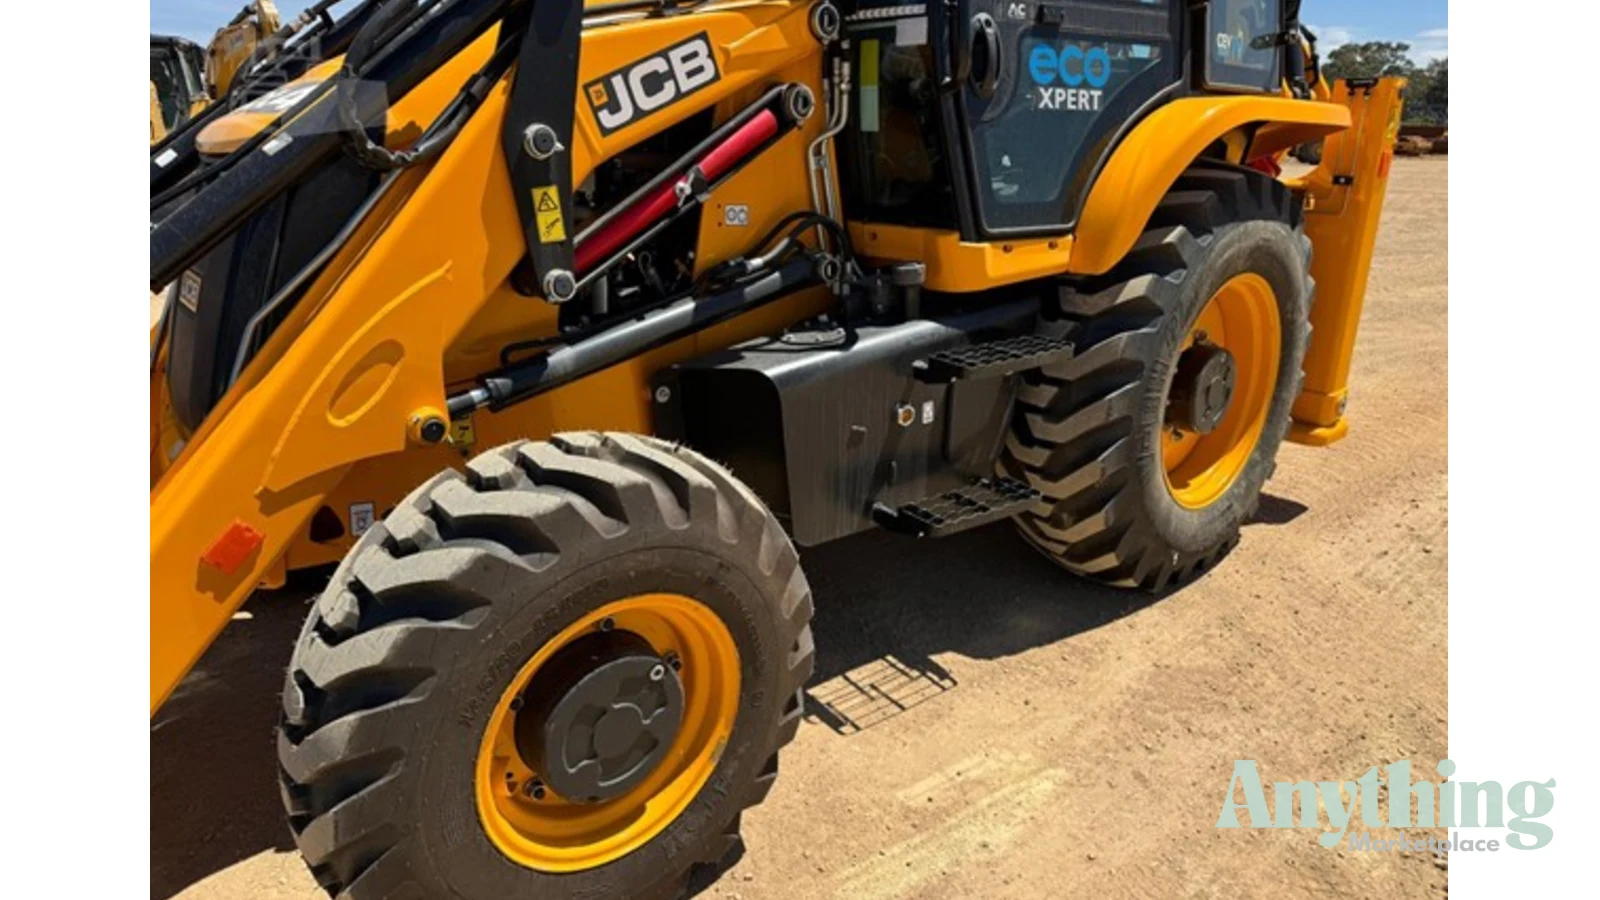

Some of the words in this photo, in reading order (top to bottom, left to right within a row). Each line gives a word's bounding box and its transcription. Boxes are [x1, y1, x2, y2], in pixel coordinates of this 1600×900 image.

[598, 39, 715, 129] JCB
[1028, 43, 1110, 87] eco
[1038, 86, 1102, 111] XPERT
